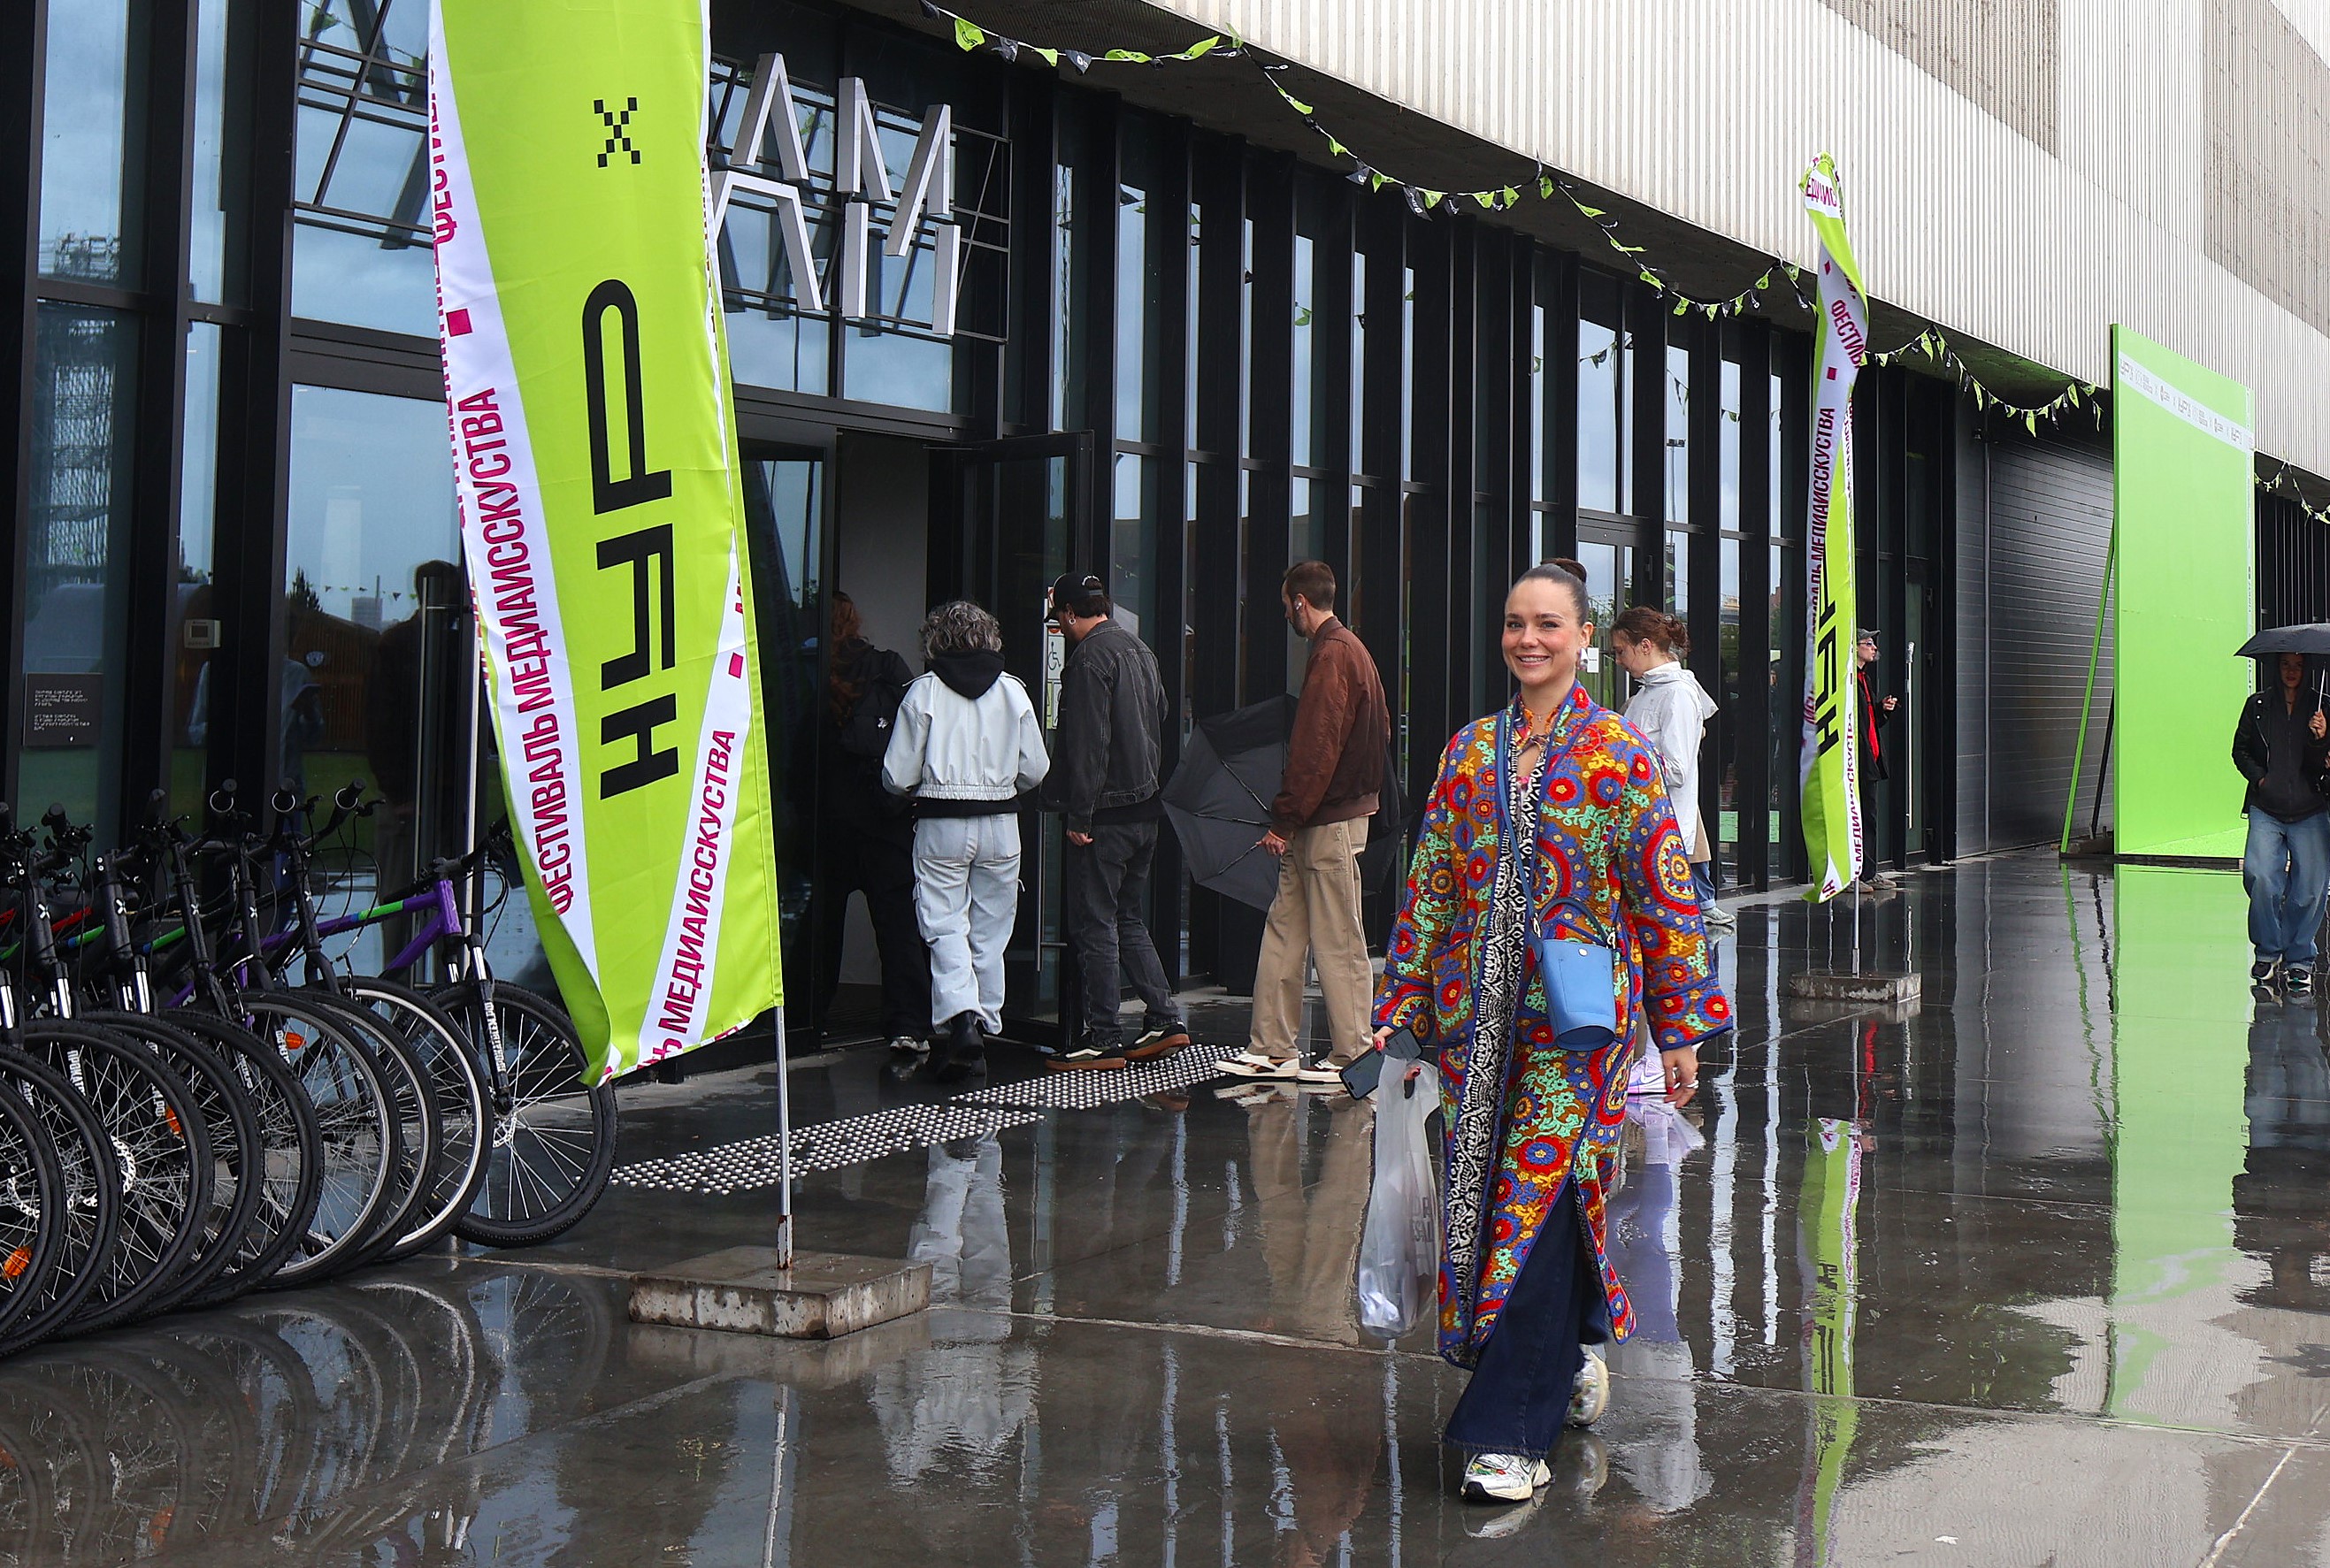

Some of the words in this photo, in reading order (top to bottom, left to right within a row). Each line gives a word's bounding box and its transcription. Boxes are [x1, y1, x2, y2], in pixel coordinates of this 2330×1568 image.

[457, 386, 556, 714] МЕДИАИССКУСТВА
[522, 714, 573, 915] ФЕСТИВАЛЬ
[657, 730, 736, 1035] МЕДИАИССКУСТВА
